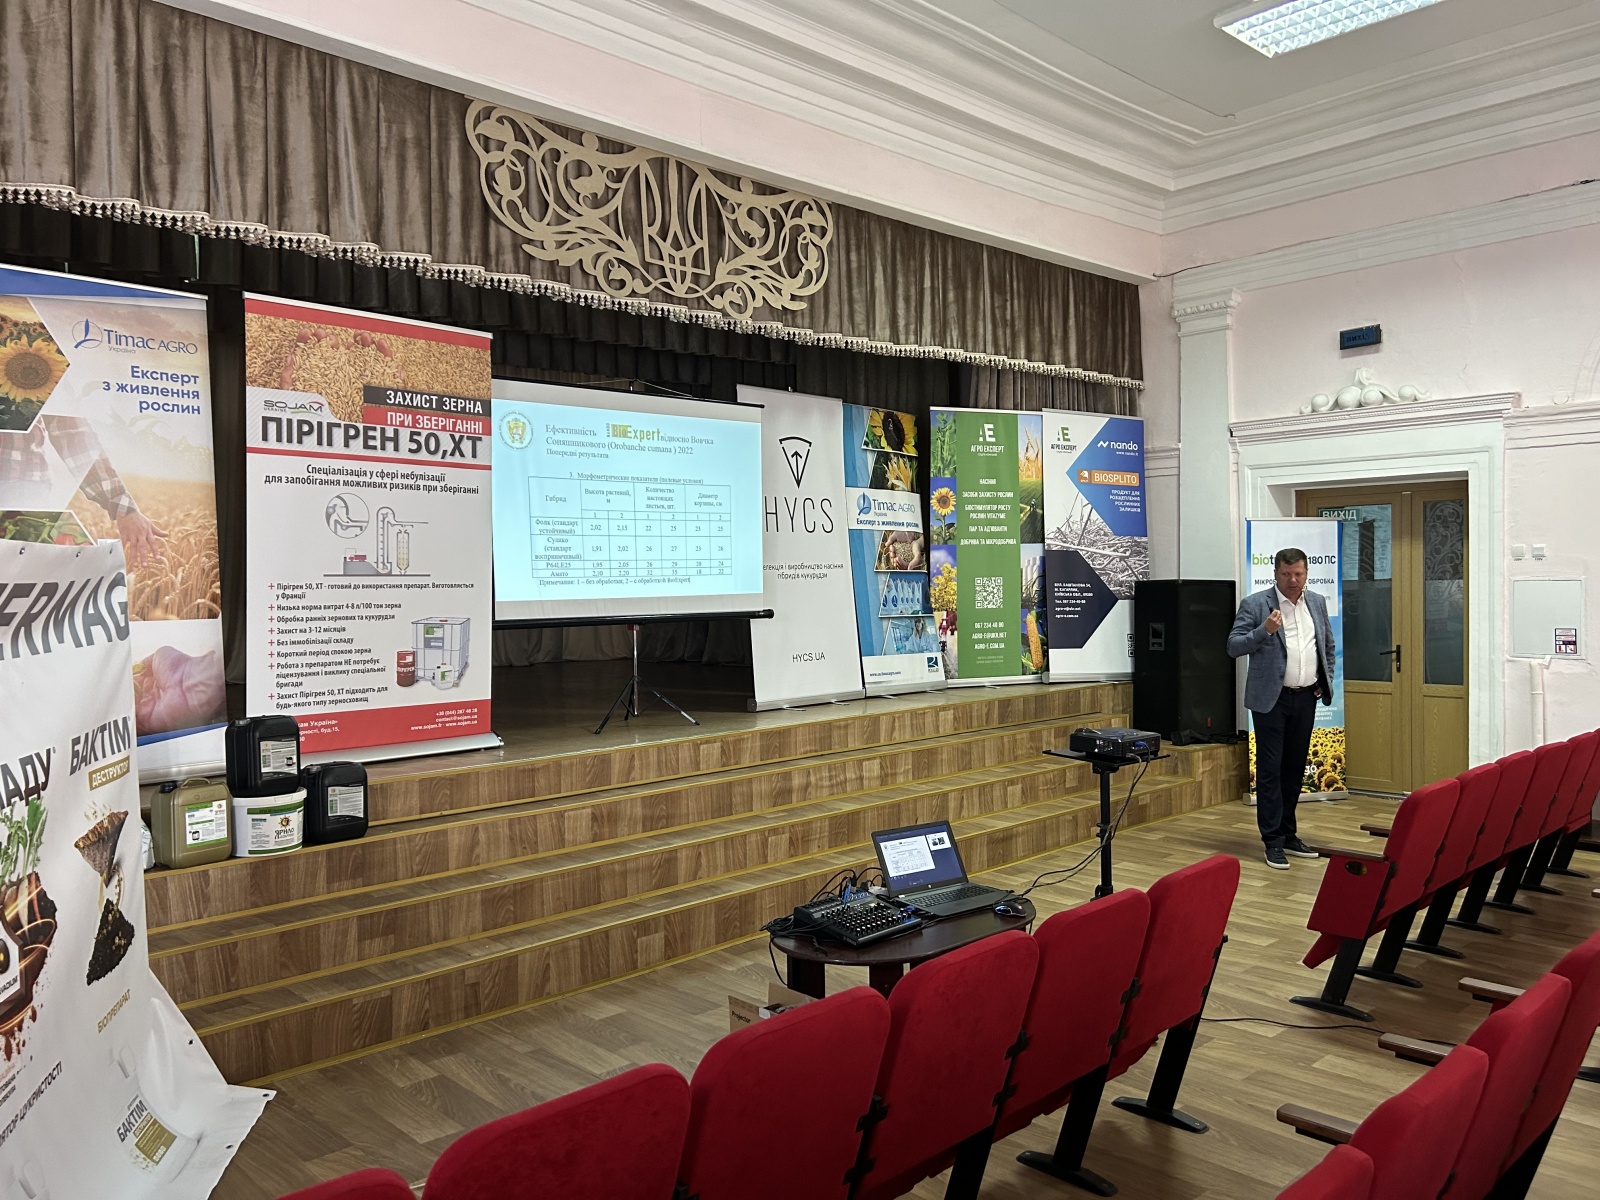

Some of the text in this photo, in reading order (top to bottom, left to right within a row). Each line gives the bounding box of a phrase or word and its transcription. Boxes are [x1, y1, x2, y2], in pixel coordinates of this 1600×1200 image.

[103, 328, 198, 354] Timac AGRO
[108, 345, 136, 354] Україна
[131, 365, 199, 386] Експерт
[102, 381, 200, 400] з живлення
[139, 400, 200, 415] рослин
[263, 400, 323, 412] SOJAM
[386, 390, 483, 414] ЗАХИСТ ЗЕРНА
[387, 411, 412, 427] ПРИ
[415, 415, 483, 434] ЗБЕРІГАННІ
[261, 415, 399, 452] ПІРІГРЕН
[407, 430, 483, 460] 50,ХТ
[545, 424, 597, 437] Ефективність
[611, 424, 661, 442] BioExpert
[546, 436, 694, 455] Соняшникового (Orobanche cumana 2022
[970, 445, 1005, 453] АГРО ЕКСПЕРТ
[1061, 444, 1077, 452] ЕКСПЕРТ
[1110, 441, 1139, 451] nando
[306, 464, 446, 483] Спеціалізація у сфері небулізації
[1094, 472, 1137, 484] BIOSPLITO
[264, 475, 479, 495] для запобігання можливих ризиків при зберіганні
[872, 499, 916, 514] Timac AGRO
[764, 495, 834, 533] HYCS
[1322, 509, 1357, 521] ВИХІД
[856, 517, 876, 527] Експерт
[960, 538, 980, 546] ДОБРИВА
[985, 538, 1017, 546] МІКРОДОБРИВА
[1252, 553, 1336, 566] biot 180 ПС
[762, 563, 784, 572] елекція
[788, 562, 823, 572] виробництво
[777, 571, 800, 580] гібридів
[276, 583, 303, 592] Пірігрен
[305, 583, 314, 591] 50,
[352, 583, 361, 591] до
[276, 592, 306, 601] у Франції
[355, 602, 373, 610] л/100
[0, 571, 130, 660] ERMAG
[276, 615, 304, 624] Обробка
[364, 614, 395, 622] кукурудзи
[276, 627, 298, 635] Захист
[308, 626, 322, 634] 3-12
[323, 625, 346, 634] місяців
[971, 632, 1007, 640] AGRO-E@UKR.NET
[289, 637, 332, 646] іммобілізації
[333, 637, 354, 645] складу
[974, 642, 1005, 650] AGRO-E.COM.UA
[276, 650, 307, 659] Короткий
[308, 649, 329, 658] період
[354, 647, 371, 655] зерна
[792, 651, 826, 663] HYCS.UA
[276, 662, 299, 670] Робота
[305, 660, 343, 669] препаратом
[352, 658, 380, 666] потребує
[275, 665, 386, 680] ліцензування виклику спеціальної
[275, 681, 303, 689] бригади
[276, 692, 298, 700] Захист
[299, 691, 326, 699] Пірігрен
[376, 685, 388, 693] для
[275, 701, 311, 710] будь-якого
[328, 697, 369, 705] зерносховищ
[69, 716, 131, 777] БАКТІМ
[0, 747, 51, 810] АДУ
[92, 760, 129, 788] ДЕСТРУКТОР
[731, 1010, 751, 1024] Projector
[19, 1060, 63, 1122] ЦУКРИСТОСТІ
[116, 1099, 148, 1143] БАКТІМ
